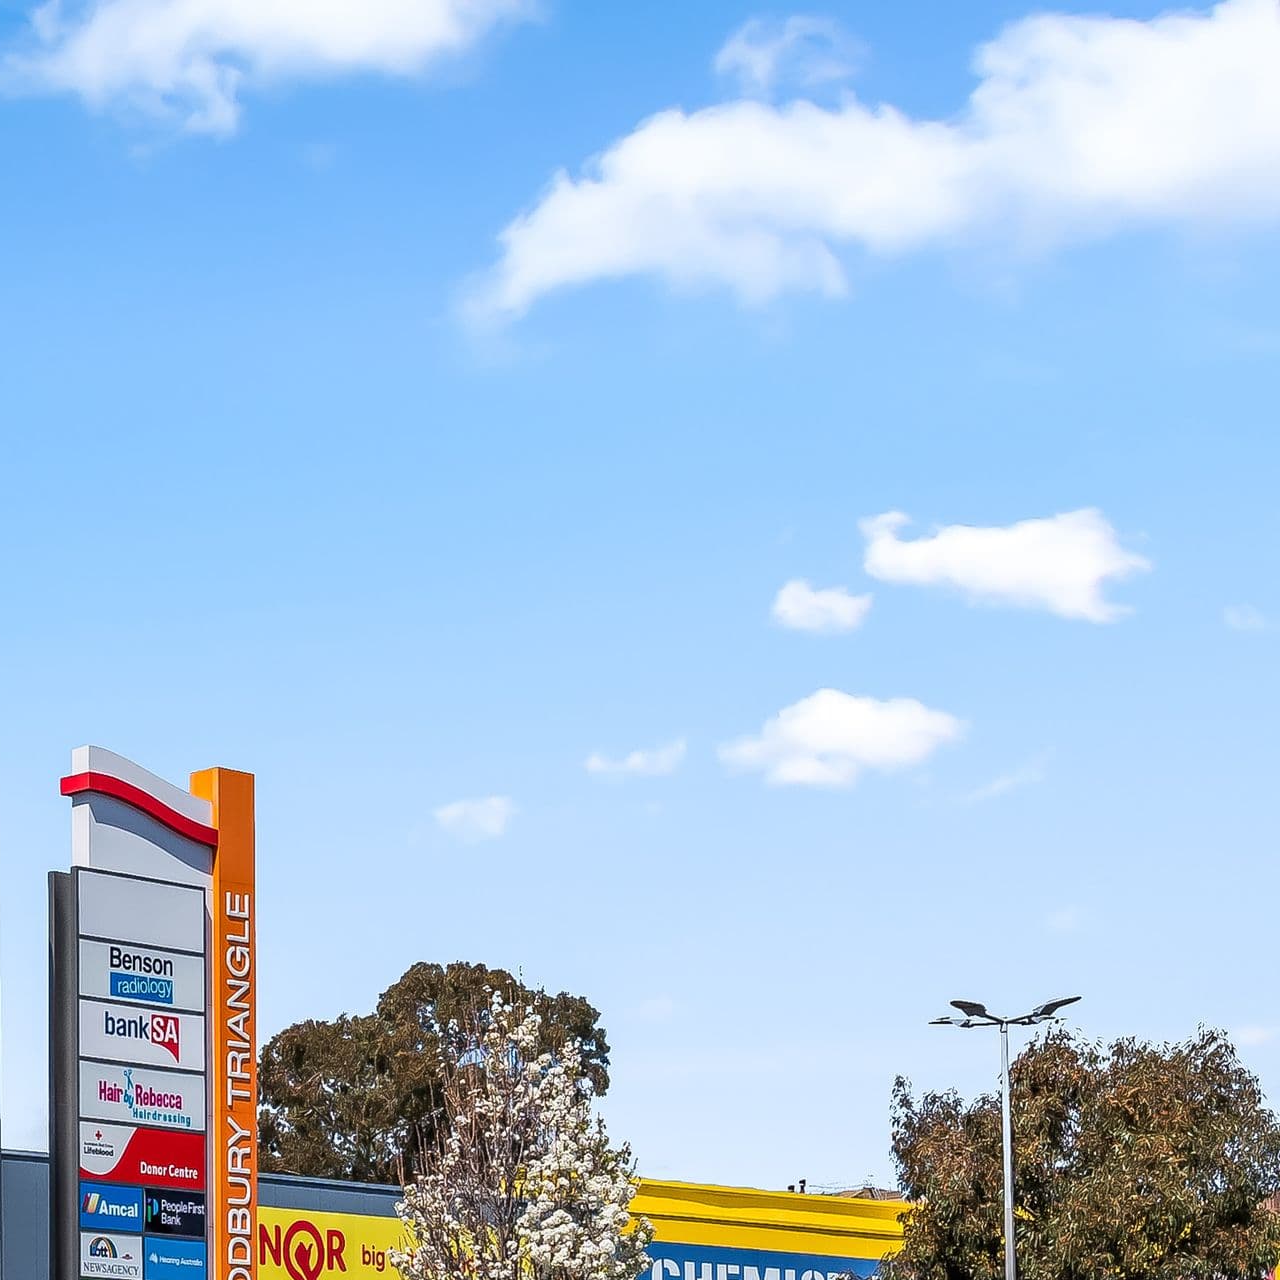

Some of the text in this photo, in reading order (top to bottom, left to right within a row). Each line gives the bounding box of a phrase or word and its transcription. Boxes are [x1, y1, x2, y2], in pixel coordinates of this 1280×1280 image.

[109, 946, 174, 977] Benson
[117, 977, 172, 998] radiology
[225, 891, 251, 1107] TRIANGLE
[98, 1080, 182, 1110] Hair by Rebecca
[132, 1108, 191, 1127] Hairdressing
[83, 1146, 114, 1157] Lifeblood
[140, 1161, 199, 1179] Donor Centre
[99, 1199, 139, 1218] Amcal
[161, 1213, 182, 1226] Bank
[160, 1255, 180, 1266] Hearing
[361, 1244, 385, 1273] big
[82, 1261, 140, 1276] NEWSAGENCY
